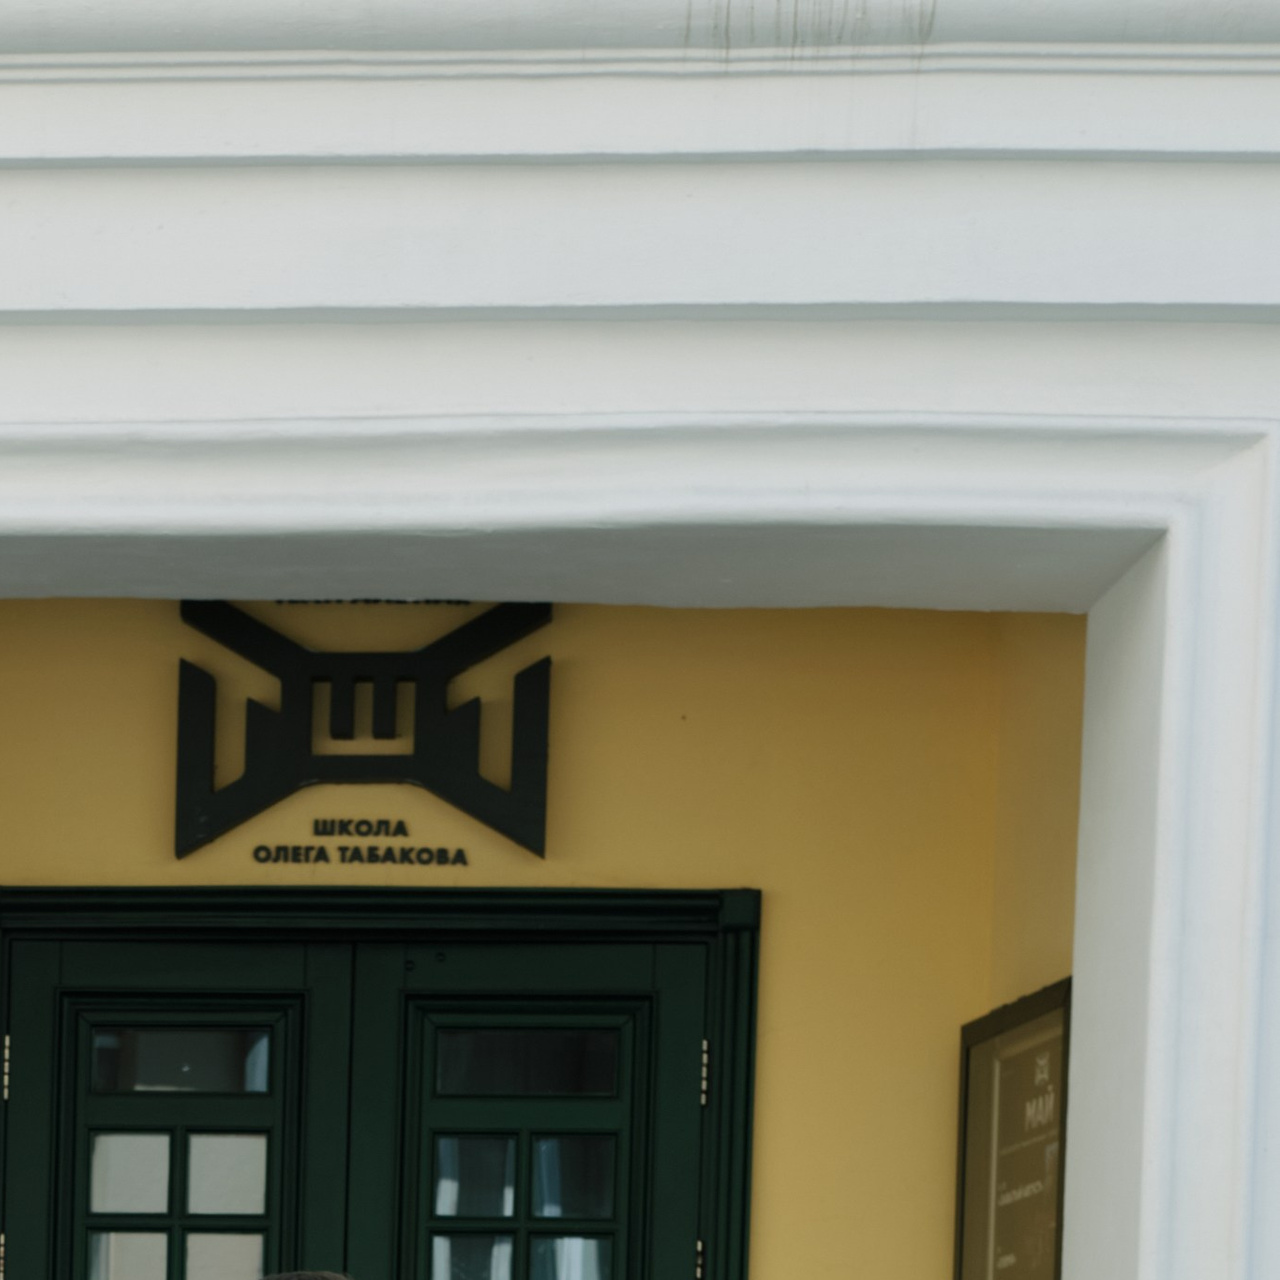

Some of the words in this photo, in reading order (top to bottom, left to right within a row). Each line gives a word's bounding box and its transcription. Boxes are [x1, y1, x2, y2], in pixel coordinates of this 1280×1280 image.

[312, 819, 409, 837] ШКОЛА
[252, 845, 330, 864] ОЛЕГА
[339, 846, 469, 866] ТАБАКОВА
[1024, 1084, 1055, 1132] МАЙ
